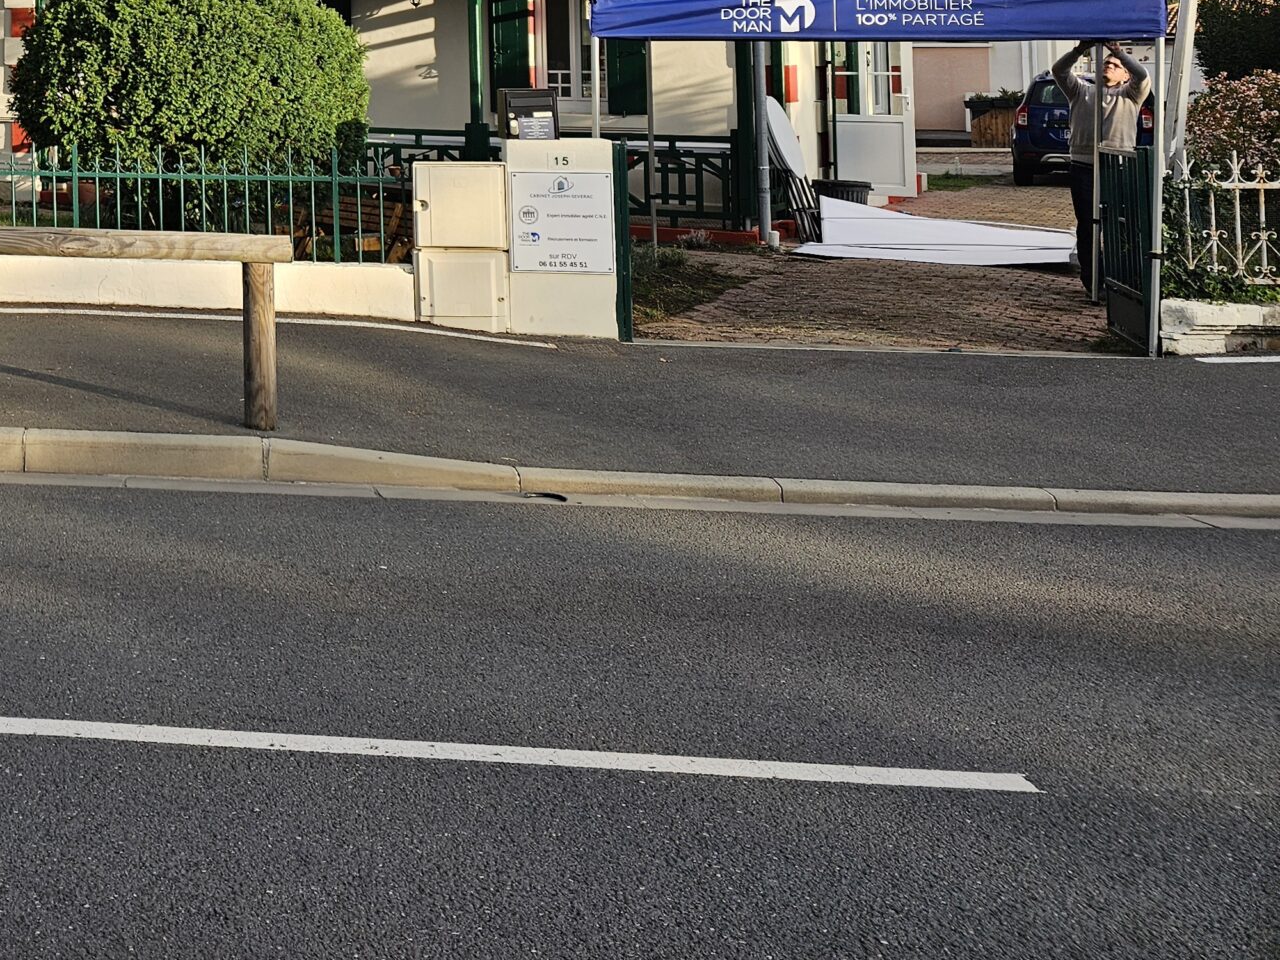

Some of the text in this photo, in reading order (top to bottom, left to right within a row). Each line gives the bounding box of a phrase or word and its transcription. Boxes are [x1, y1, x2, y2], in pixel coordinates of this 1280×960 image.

[721, 8, 772, 20] DOOR
[856, 11, 985, 26] 100% PARTAGÉ
[733, 21, 772, 33] MAN
[554, 156, 569, 166] 15
